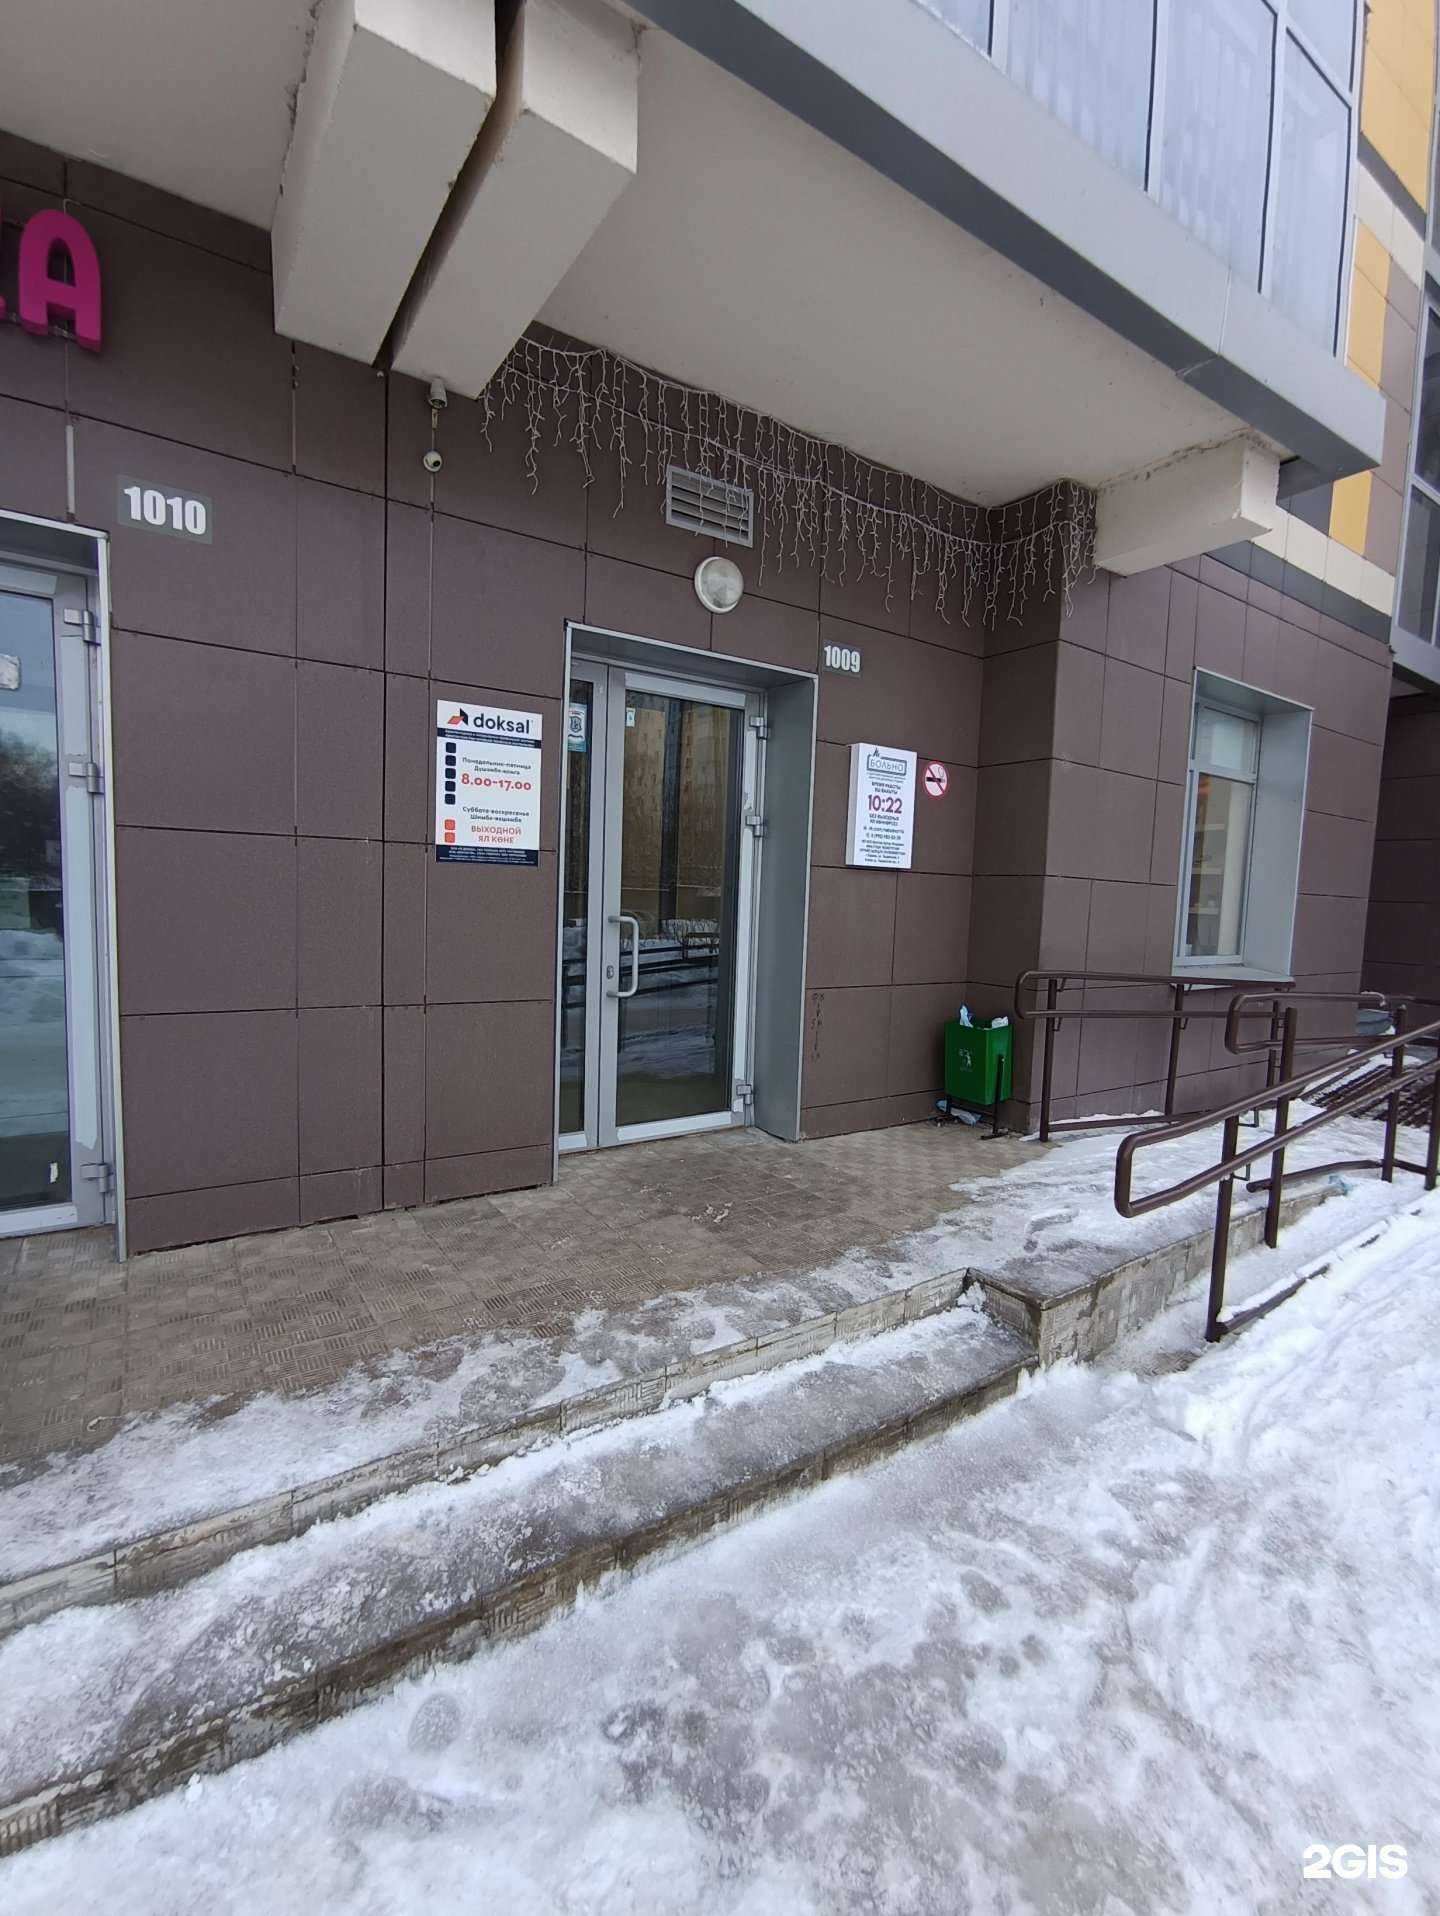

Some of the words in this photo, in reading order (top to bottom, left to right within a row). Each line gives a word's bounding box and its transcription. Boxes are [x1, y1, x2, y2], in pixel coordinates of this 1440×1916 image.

[0, 208, 102, 352] А
[123, 486, 206, 535] 1010
[823, 645, 861, 673] 1009
[473, 713, 530, 734] doksal
[870, 759, 904, 772] БОЛЬНО
[461, 773, 532, 791] 8.00-17.00
[868, 794, 902, 814] 10:22
[471, 825, 522, 836] ВЫХОДНОЙ
